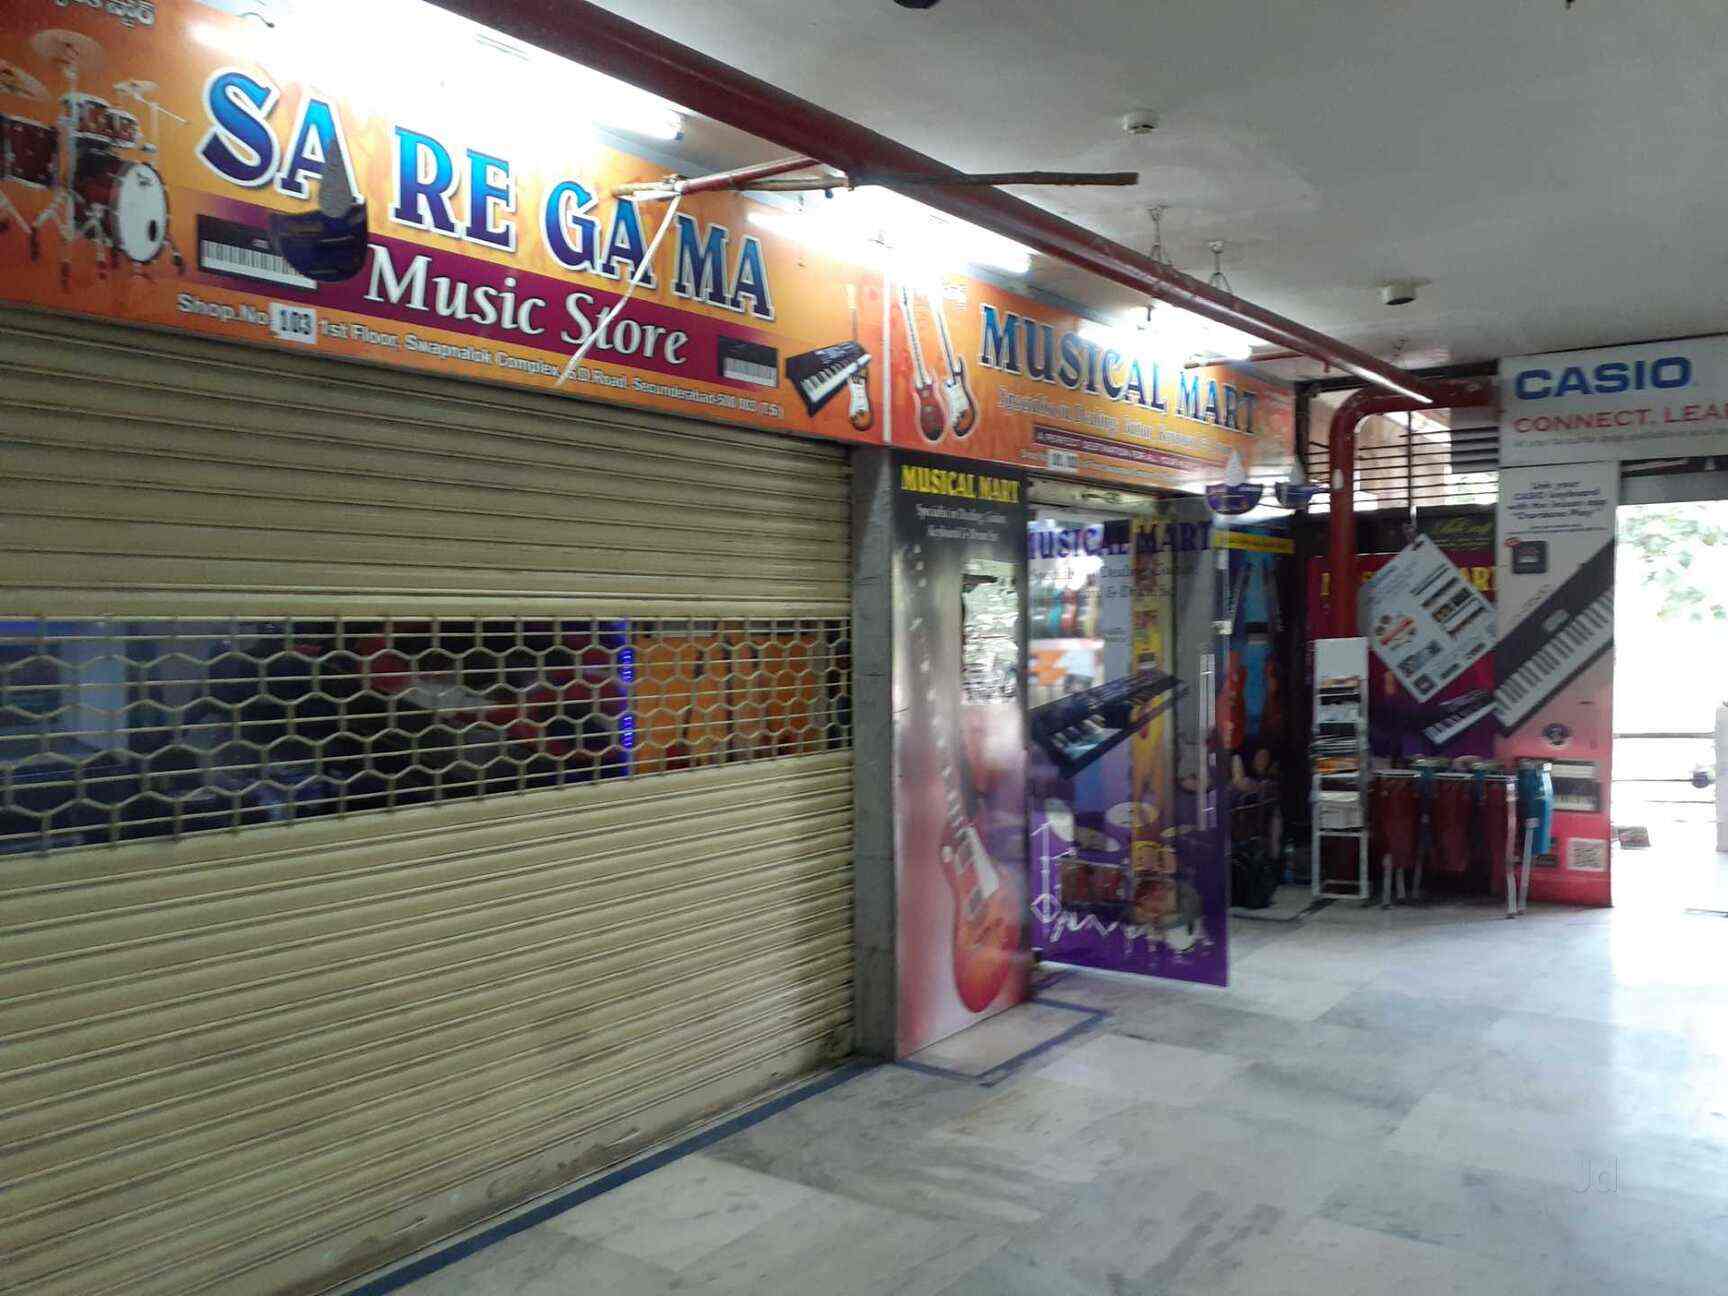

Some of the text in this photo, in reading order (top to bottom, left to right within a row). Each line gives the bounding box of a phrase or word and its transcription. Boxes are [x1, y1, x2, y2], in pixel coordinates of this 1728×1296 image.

[197, 68, 775, 321] SA RE GA MA
[363, 243, 689, 365] Music Store
[977, 303, 1259, 436] MUSICAL MART
[1514, 356, 1693, 401] CASIO
[1662, 400, 1728, 425] LEA
[901, 464, 1020, 505] MUSICAL MART
